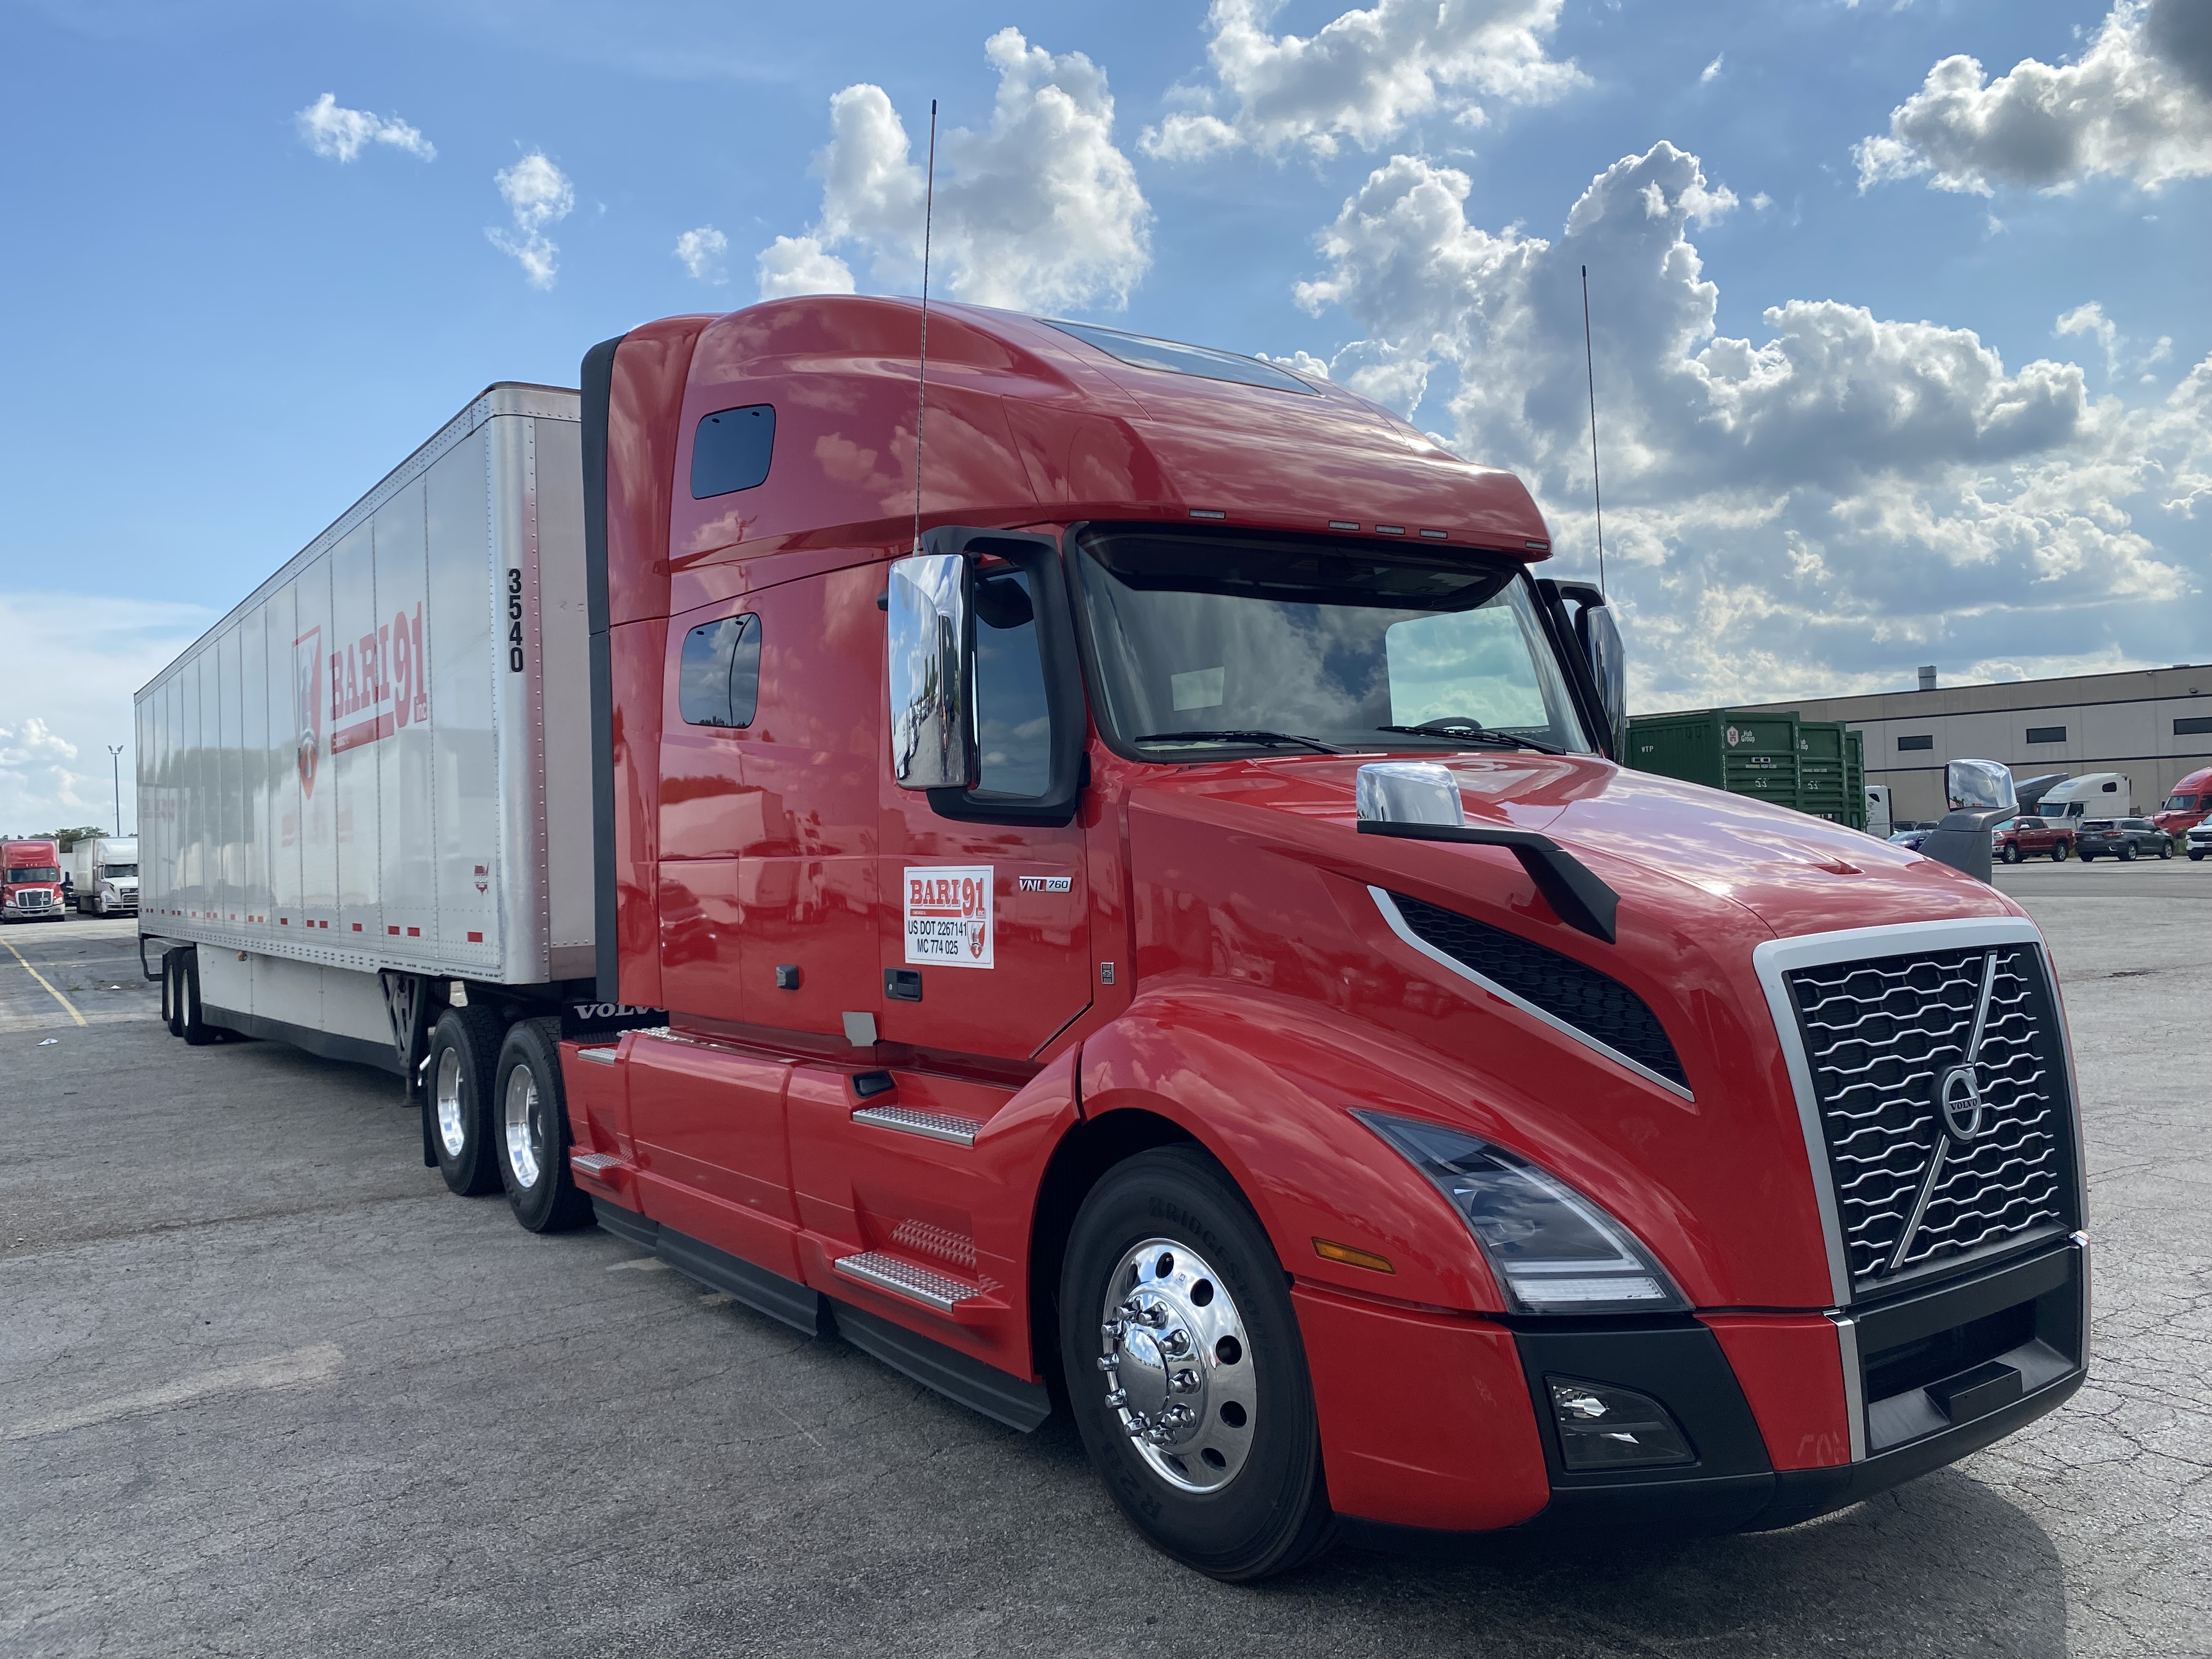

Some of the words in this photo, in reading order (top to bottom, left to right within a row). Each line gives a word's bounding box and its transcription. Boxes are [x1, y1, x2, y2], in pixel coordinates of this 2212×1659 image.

[509, 568, 523, 673] 3540
[329, 624, 390, 721] BARI
[393, 601, 427, 728] 91
[416, 699, 427, 720] inc
[1741, 735, 1756, 743] Group
[1019, 879, 1046, 891] VNL
[1048, 880, 1068, 889] 760
[910, 879, 960, 906] BARI
[962, 877, 985, 917] 91
[908, 920, 918, 935] US
[920, 921, 936, 935] DOT
[937, 921, 967, 936] 2267141
[917, 938, 929, 953] MC
[930, 939, 943, 953] 774
[945, 940, 958, 955] 025
[1950, 1099, 1978, 1111] VOLVO
